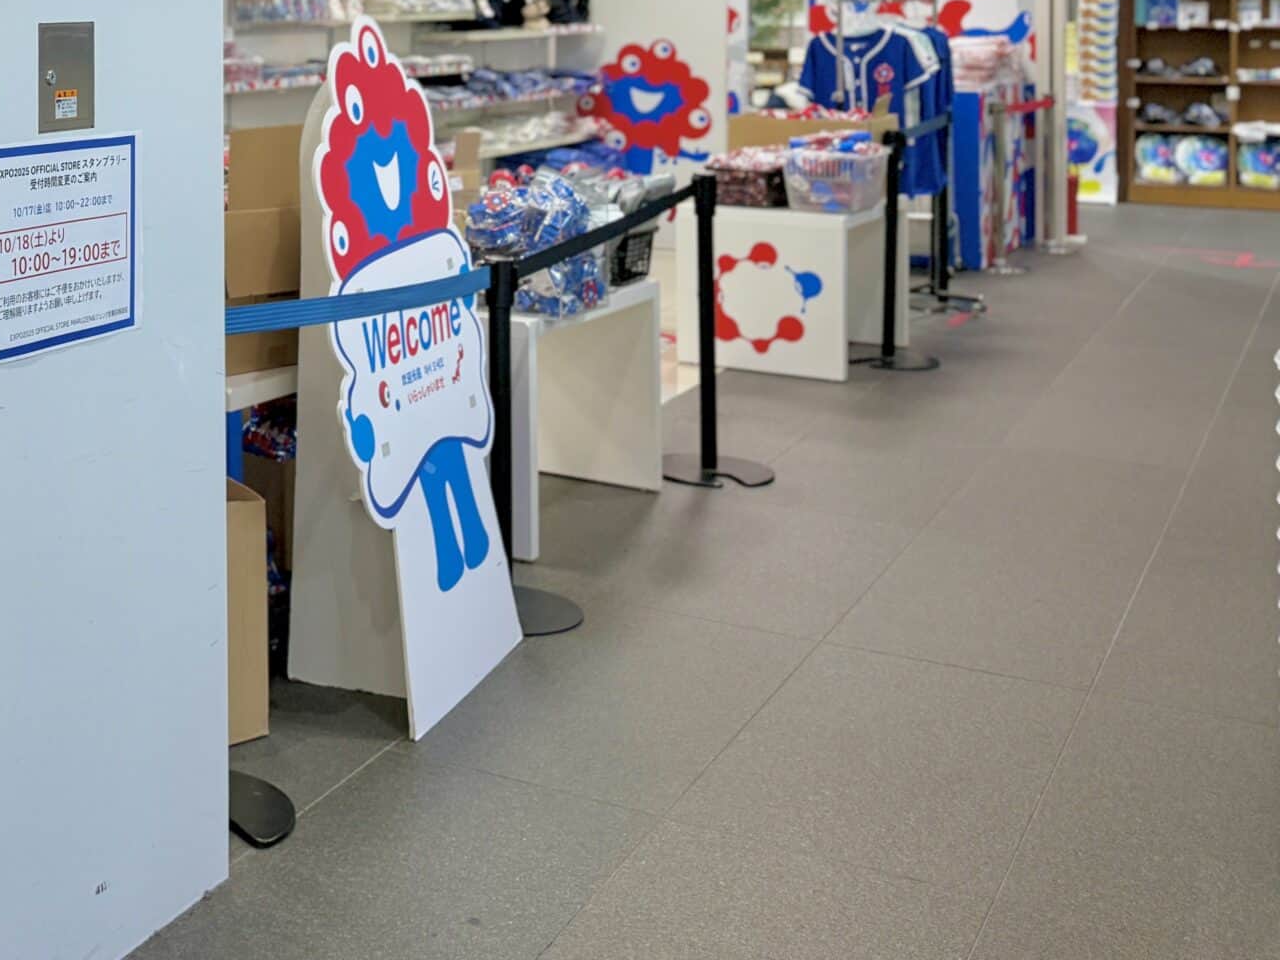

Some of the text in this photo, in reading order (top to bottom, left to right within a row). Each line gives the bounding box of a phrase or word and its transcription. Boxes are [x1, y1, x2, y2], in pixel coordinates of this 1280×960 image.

[30, 163, 60, 176] OFFICIAL
[61, 160, 81, 172] STORE
[82, 155, 127, 169] スタンプラリー
[362, 298, 462, 374] Welcome
